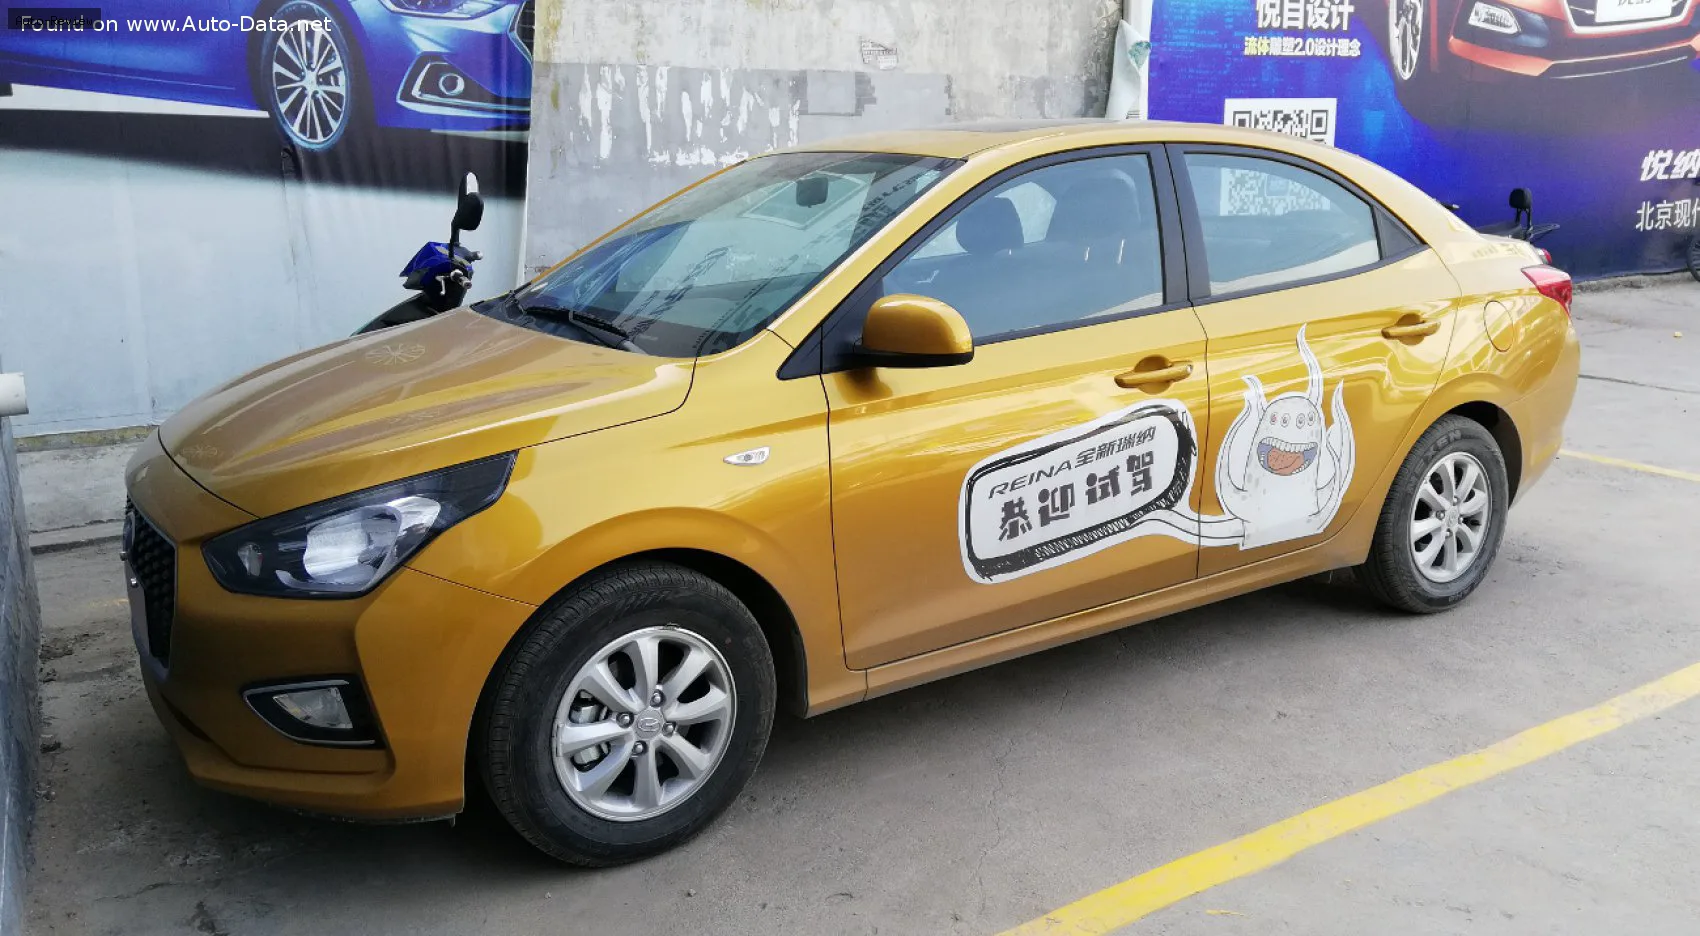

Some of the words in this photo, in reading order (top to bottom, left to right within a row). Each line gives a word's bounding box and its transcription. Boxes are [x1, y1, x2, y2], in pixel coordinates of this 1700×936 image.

[1256, 0, 1355, 31] 悦目设计
[1243, 36, 1361, 57] 流体雕塑2.0设计理念
[988, 459, 1073, 499] REINA
[1074, 425, 1157, 468] 全新瑞纳
[998, 450, 1154, 542] 恭迎试驾
